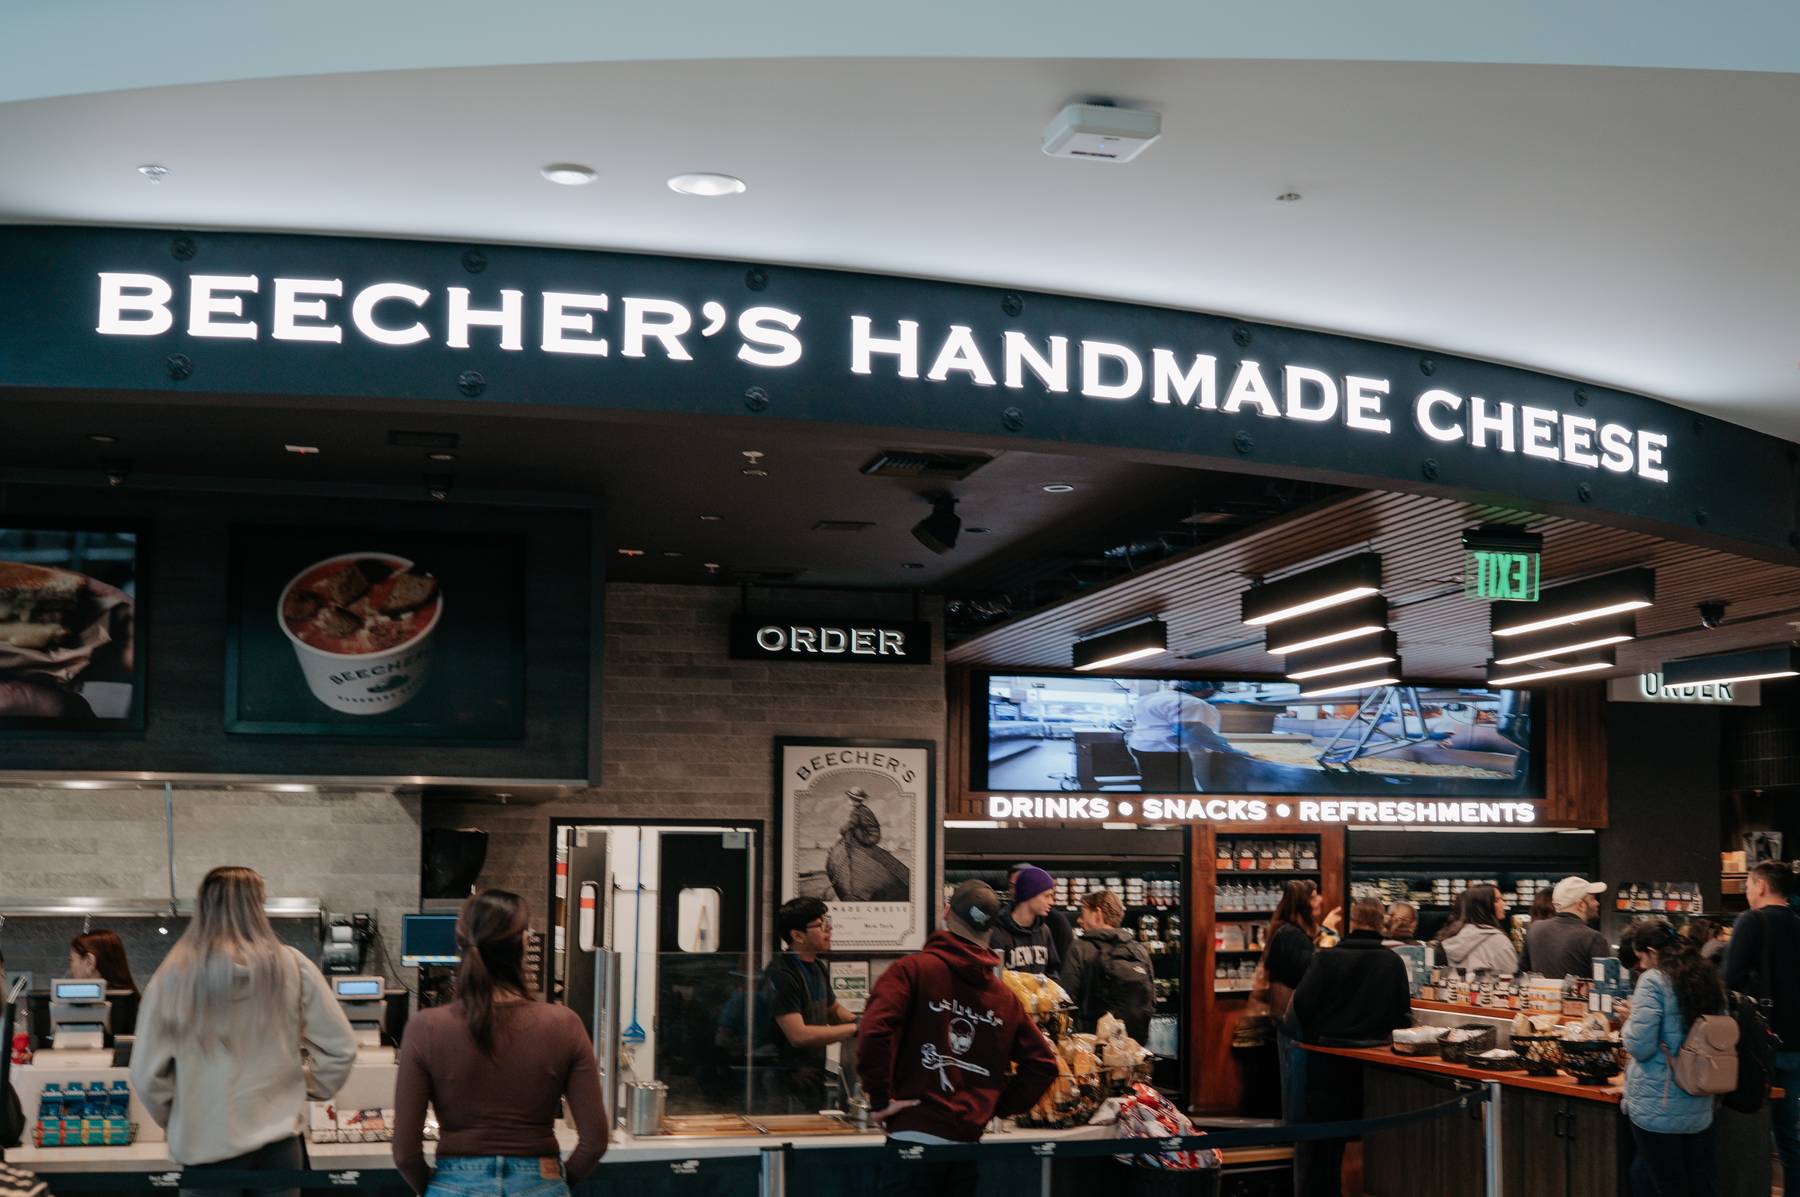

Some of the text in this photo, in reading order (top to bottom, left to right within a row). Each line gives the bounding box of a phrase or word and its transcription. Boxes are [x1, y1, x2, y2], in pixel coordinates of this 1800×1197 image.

[96, 272, 1670, 484] BEECHER'S HANDMADE CHEESE
[756, 625, 906, 656] ORDER
[795, 750, 916, 784] BEECHER'S
[988, 796, 1535, 823] DRINKS SNACKS REFRESHMENTS
